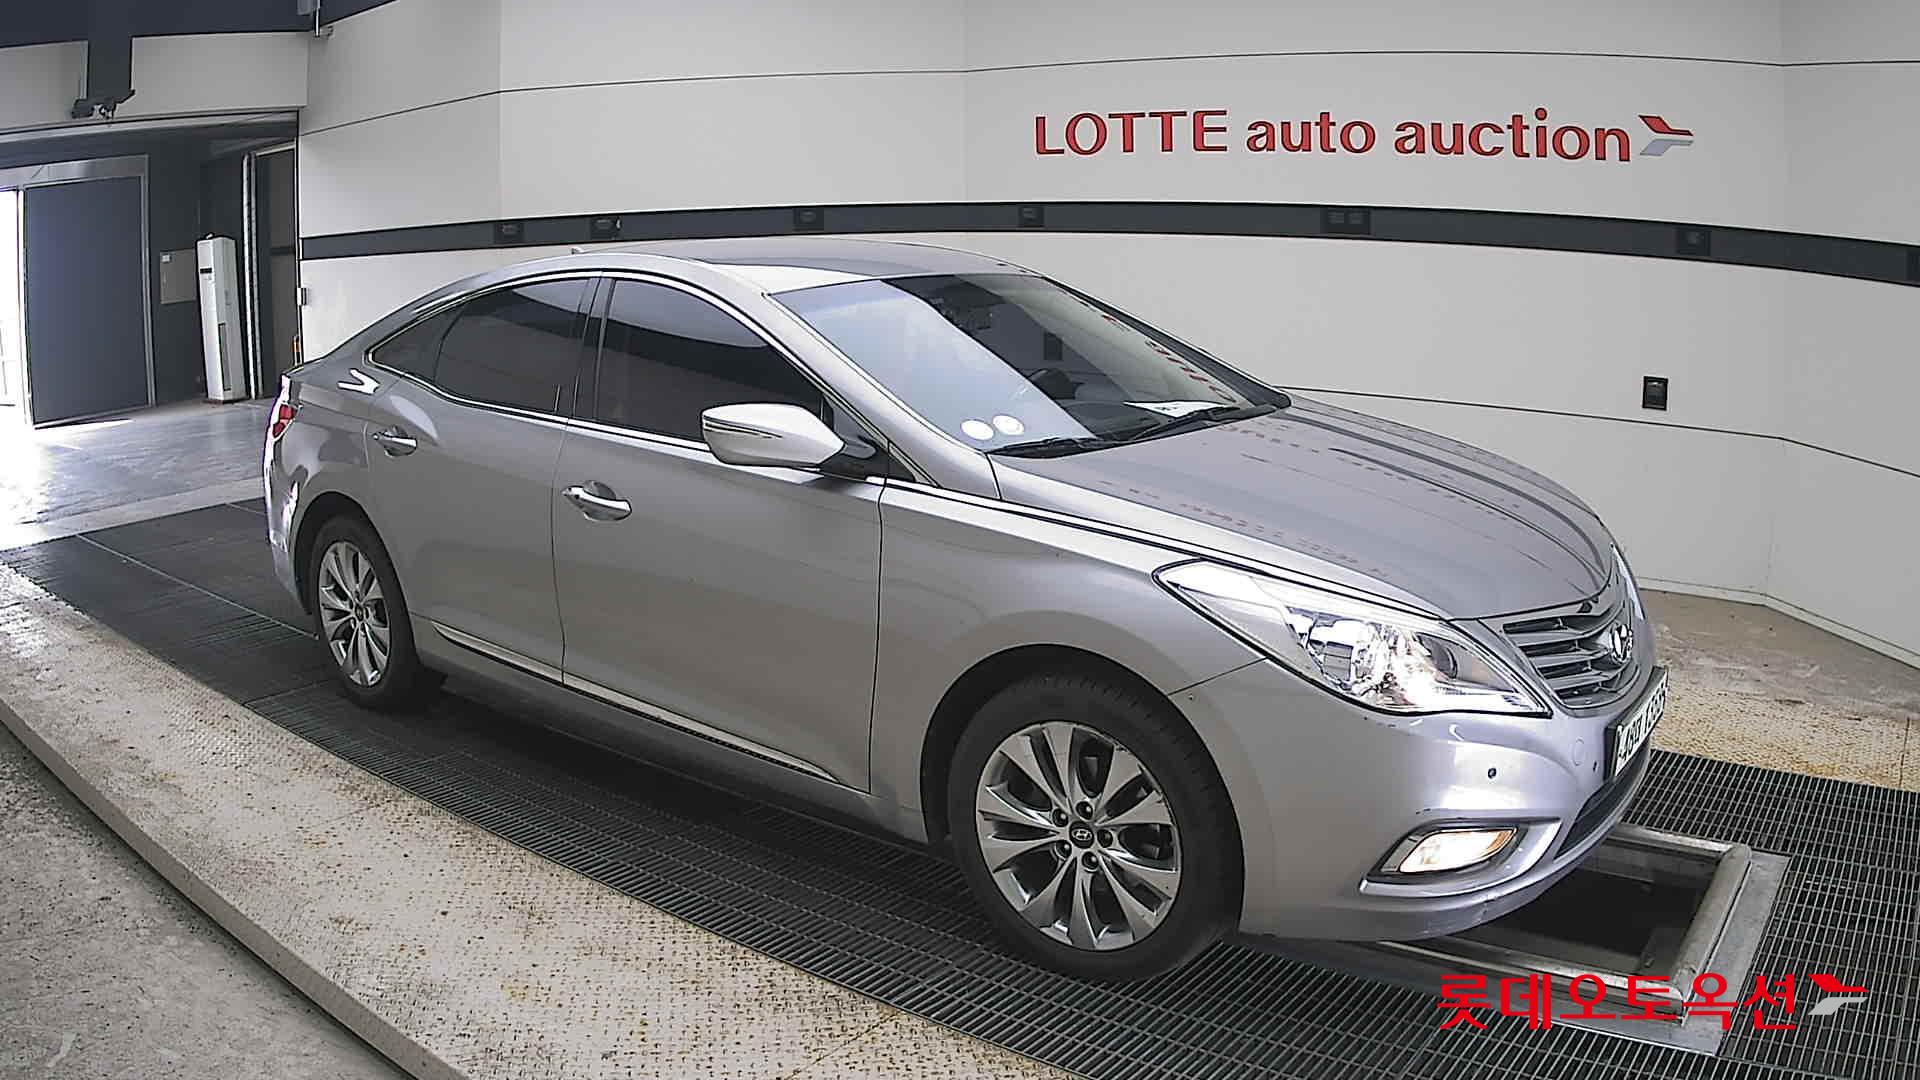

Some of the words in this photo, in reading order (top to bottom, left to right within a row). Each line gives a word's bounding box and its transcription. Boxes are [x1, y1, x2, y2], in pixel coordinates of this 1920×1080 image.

[1035, 110, 1227, 155] LOTTE
[1246, 111, 1376, 154] auto
[1394, 107, 1631, 162] auction
